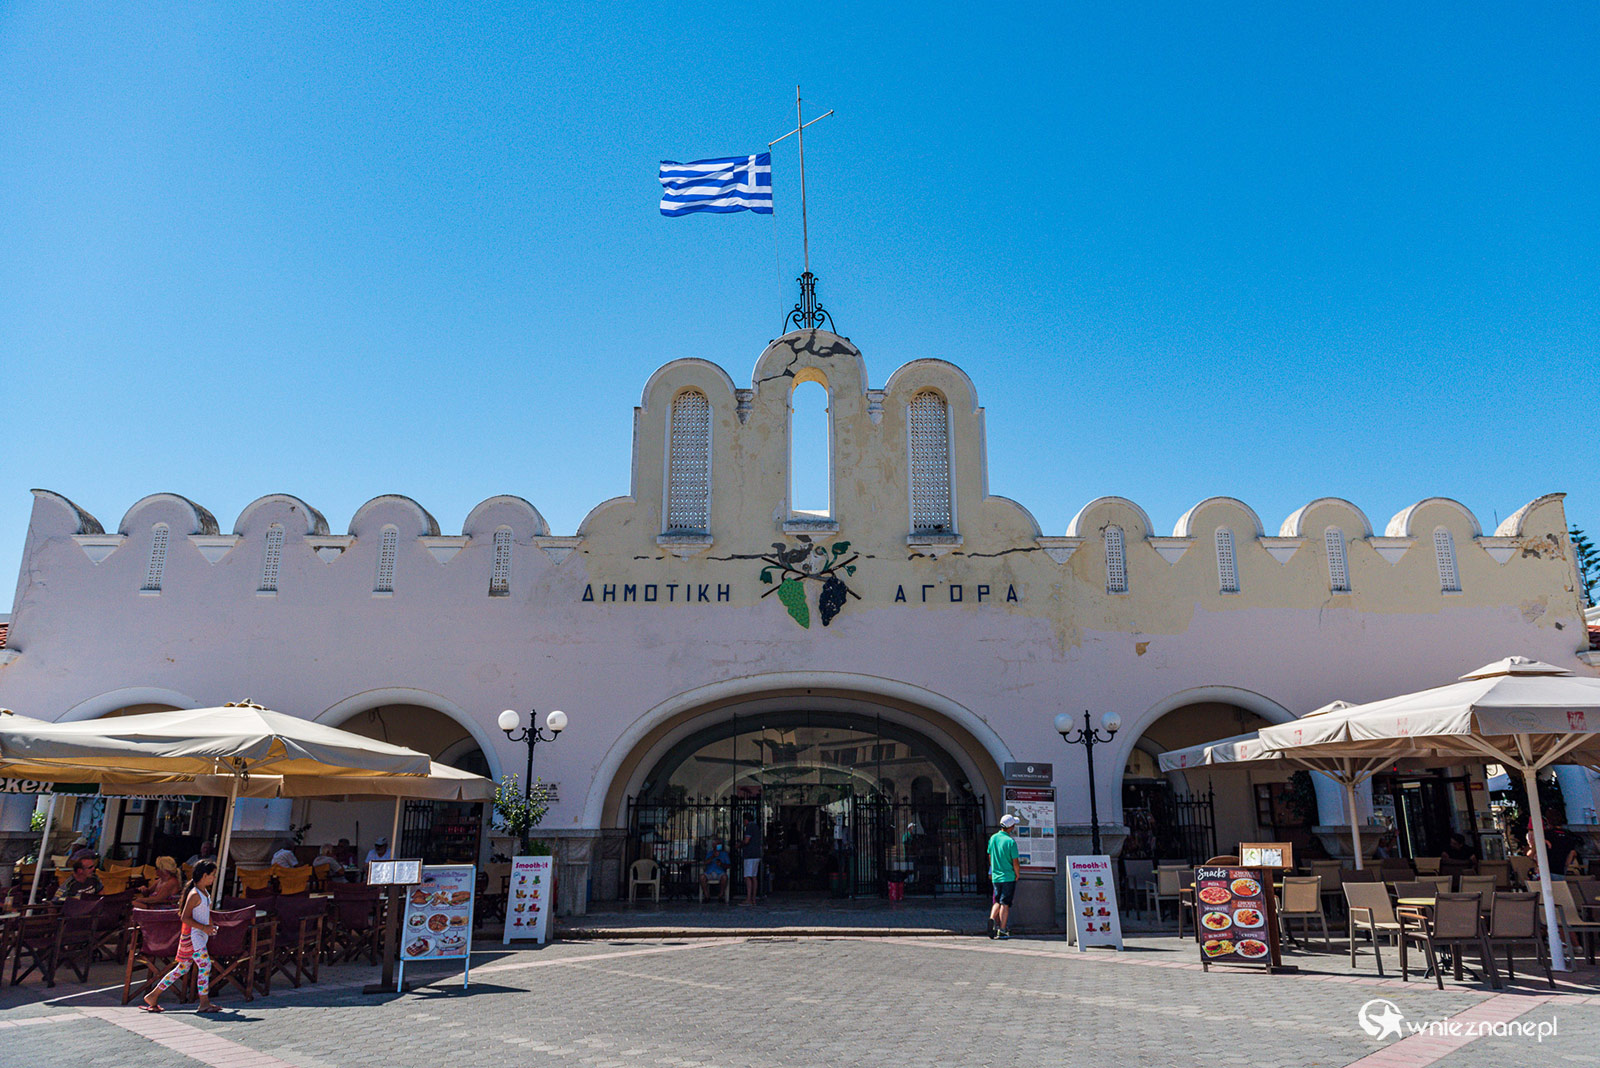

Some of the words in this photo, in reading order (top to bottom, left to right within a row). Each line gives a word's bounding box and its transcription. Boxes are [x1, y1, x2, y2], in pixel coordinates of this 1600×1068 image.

[581, 583, 730, 603] ΔΗΜΟΤΙΚΗ
[894, 584, 1019, 603] ΑΓΟΡΑ
[1198, 868, 1228, 880] Snacks
